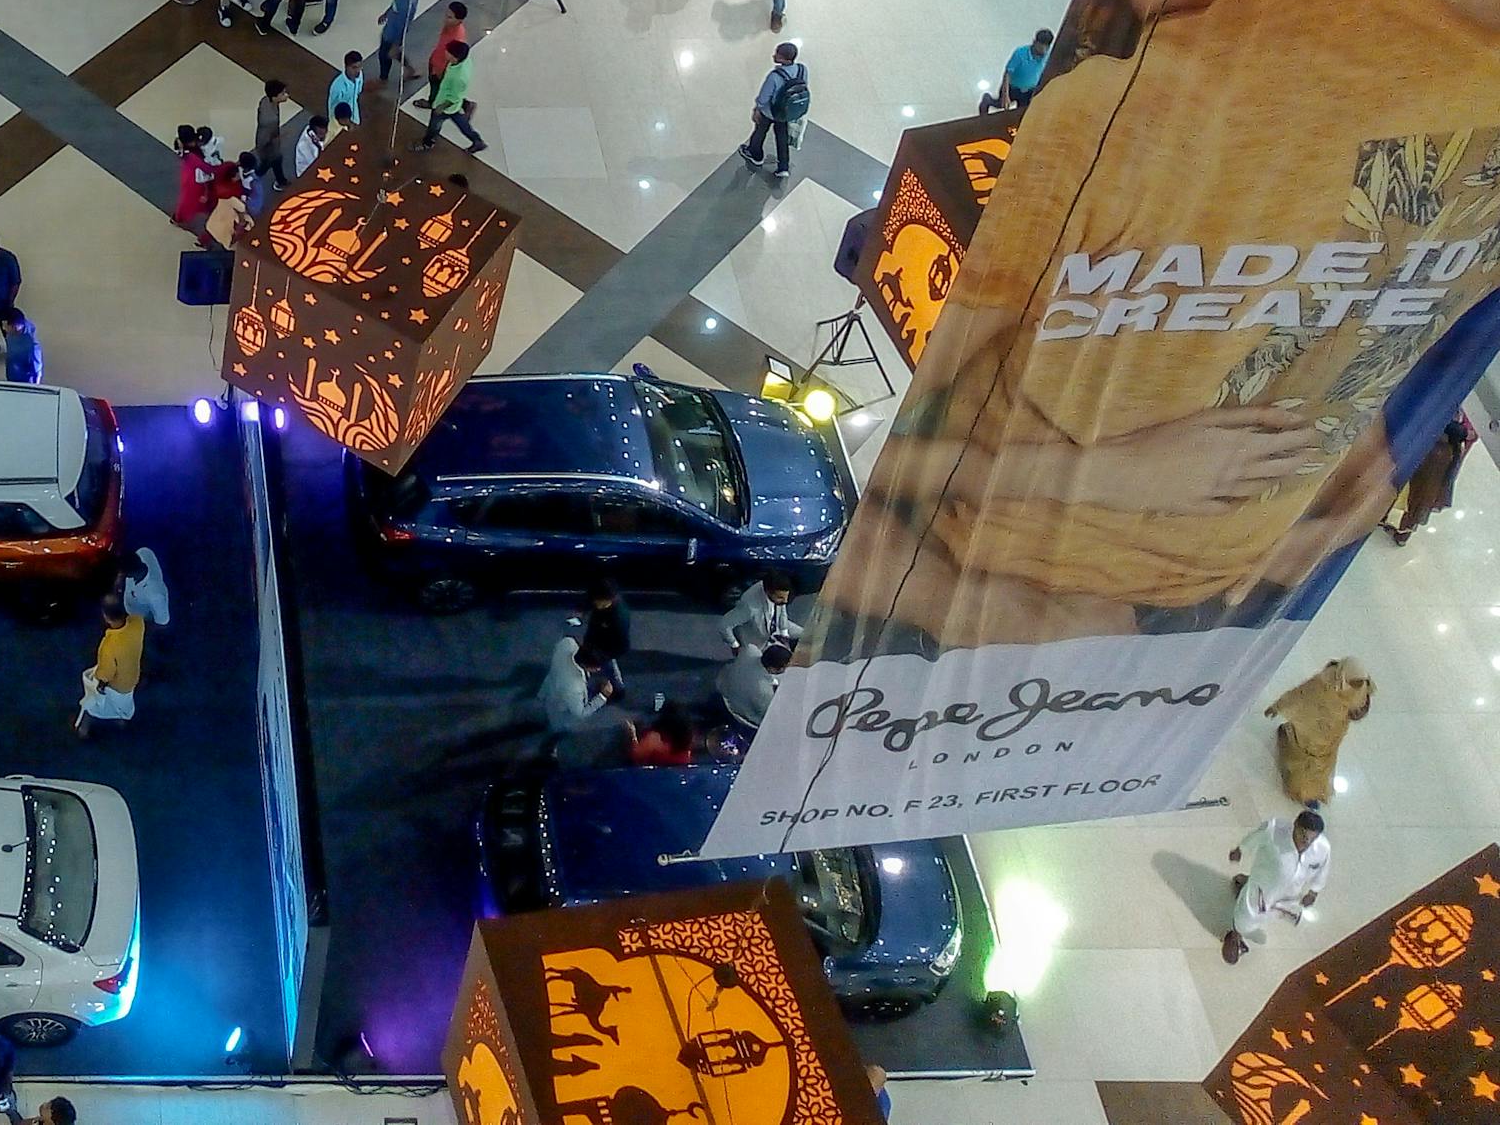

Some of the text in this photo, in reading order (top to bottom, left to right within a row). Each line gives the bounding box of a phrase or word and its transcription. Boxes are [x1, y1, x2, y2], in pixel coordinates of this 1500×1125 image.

[1053, 238, 1482, 297] MADE TO
[1038, 287, 1450, 342] CREATE
[806, 678, 1224, 752] Pepe Jeans
[908, 740, 1075, 771] LONDON
[759, 774, 1163, 827] SHOP NO. F 23, FIRST FLOOR
